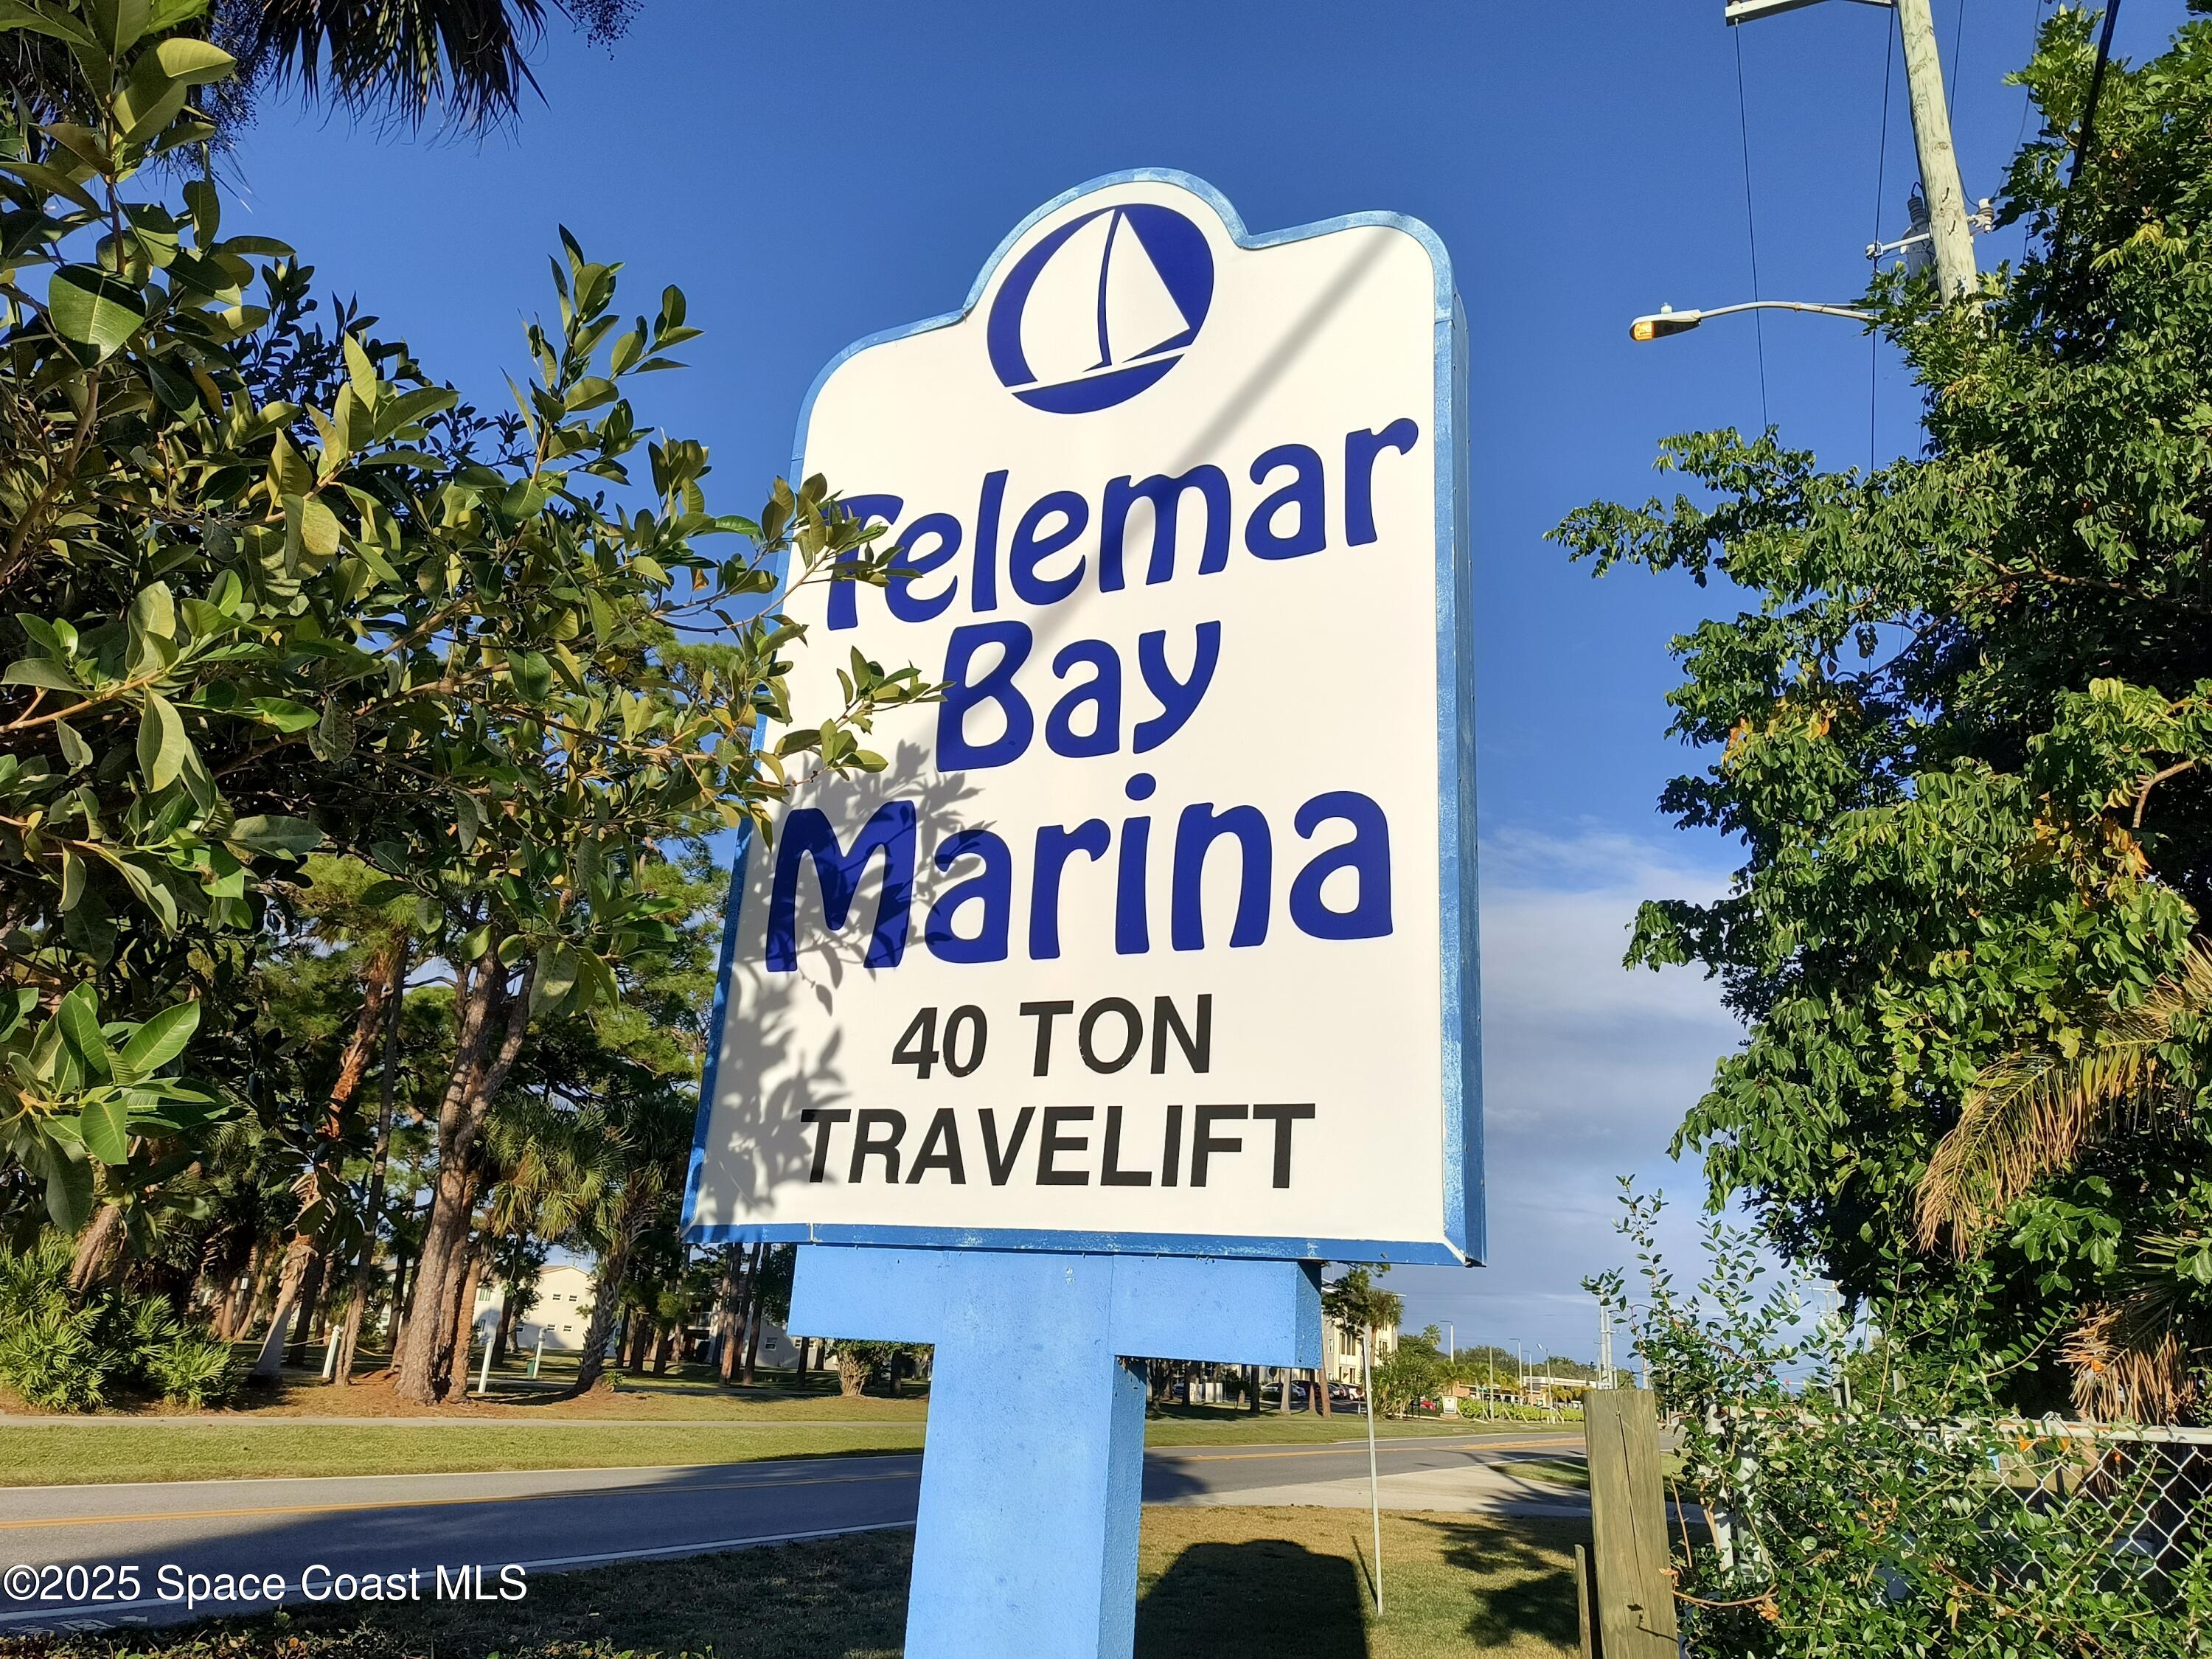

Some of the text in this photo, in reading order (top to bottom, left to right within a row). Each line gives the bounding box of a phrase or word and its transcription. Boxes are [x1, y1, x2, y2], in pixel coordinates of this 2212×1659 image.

[820, 418, 1419, 631] Telemar
[936, 620, 1222, 773] Bay
[765, 773, 1394, 973] Marina
[891, 992, 1213, 1080] 40 TON
[800, 1102, 1316, 1189] TRAVELIFT
